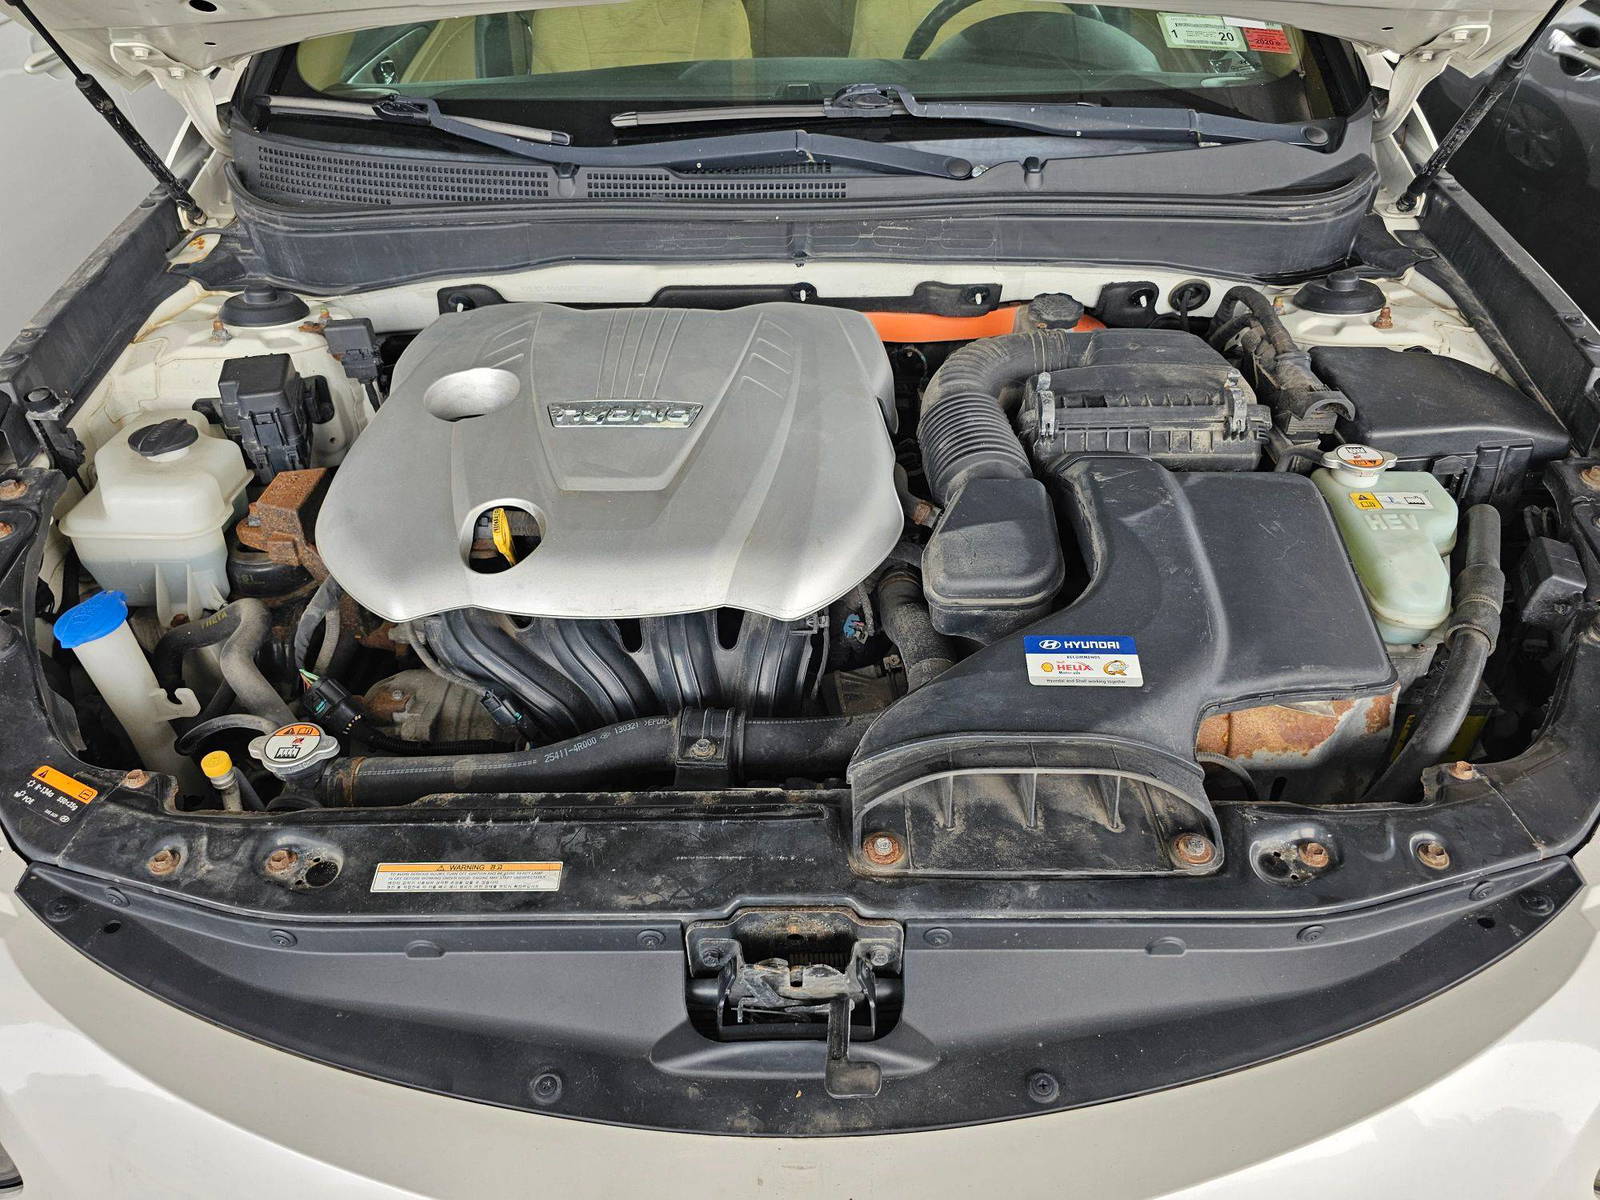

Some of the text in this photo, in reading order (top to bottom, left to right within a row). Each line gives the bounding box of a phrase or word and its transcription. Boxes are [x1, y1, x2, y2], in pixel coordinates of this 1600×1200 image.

[1218, 31, 1235, 42] 20
[1363, 513, 1419, 530] HEV
[1064, 640, 1120, 650] HYUNDAI
[1057, 663, 1094, 671] HELIX
